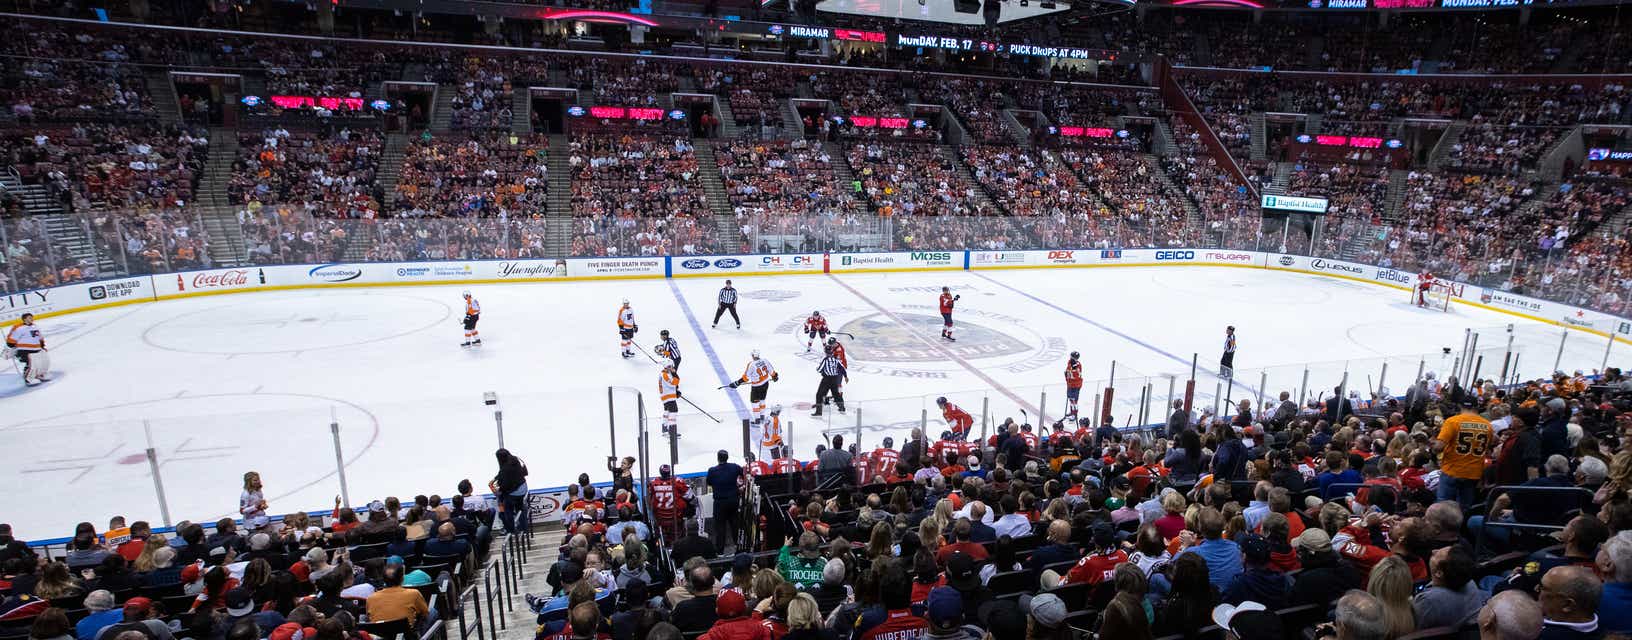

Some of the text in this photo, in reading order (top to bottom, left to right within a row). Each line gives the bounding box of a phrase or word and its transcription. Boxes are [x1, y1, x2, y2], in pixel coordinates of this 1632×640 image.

[790, 27, 829, 38] MIRAMAR
[962, 40, 973, 50] 17
[1010, 44, 1088, 59] PUCK DROPS AT 4PM
[911, 252, 951, 260] MOSS
[1048, 250, 1074, 259] DEX
[1155, 251, 1195, 260] GEICO
[1327, 263, 1363, 274] LEXUS
[1376, 269, 1410, 284] jetBlue
[106, 281, 140, 290] DOWNLOAD
[120, 289, 133, 297] APP
[1530, 302, 1541, 310] JOE
[1456, 431, 1489, 456] 53
[655, 492, 674, 509] 72
